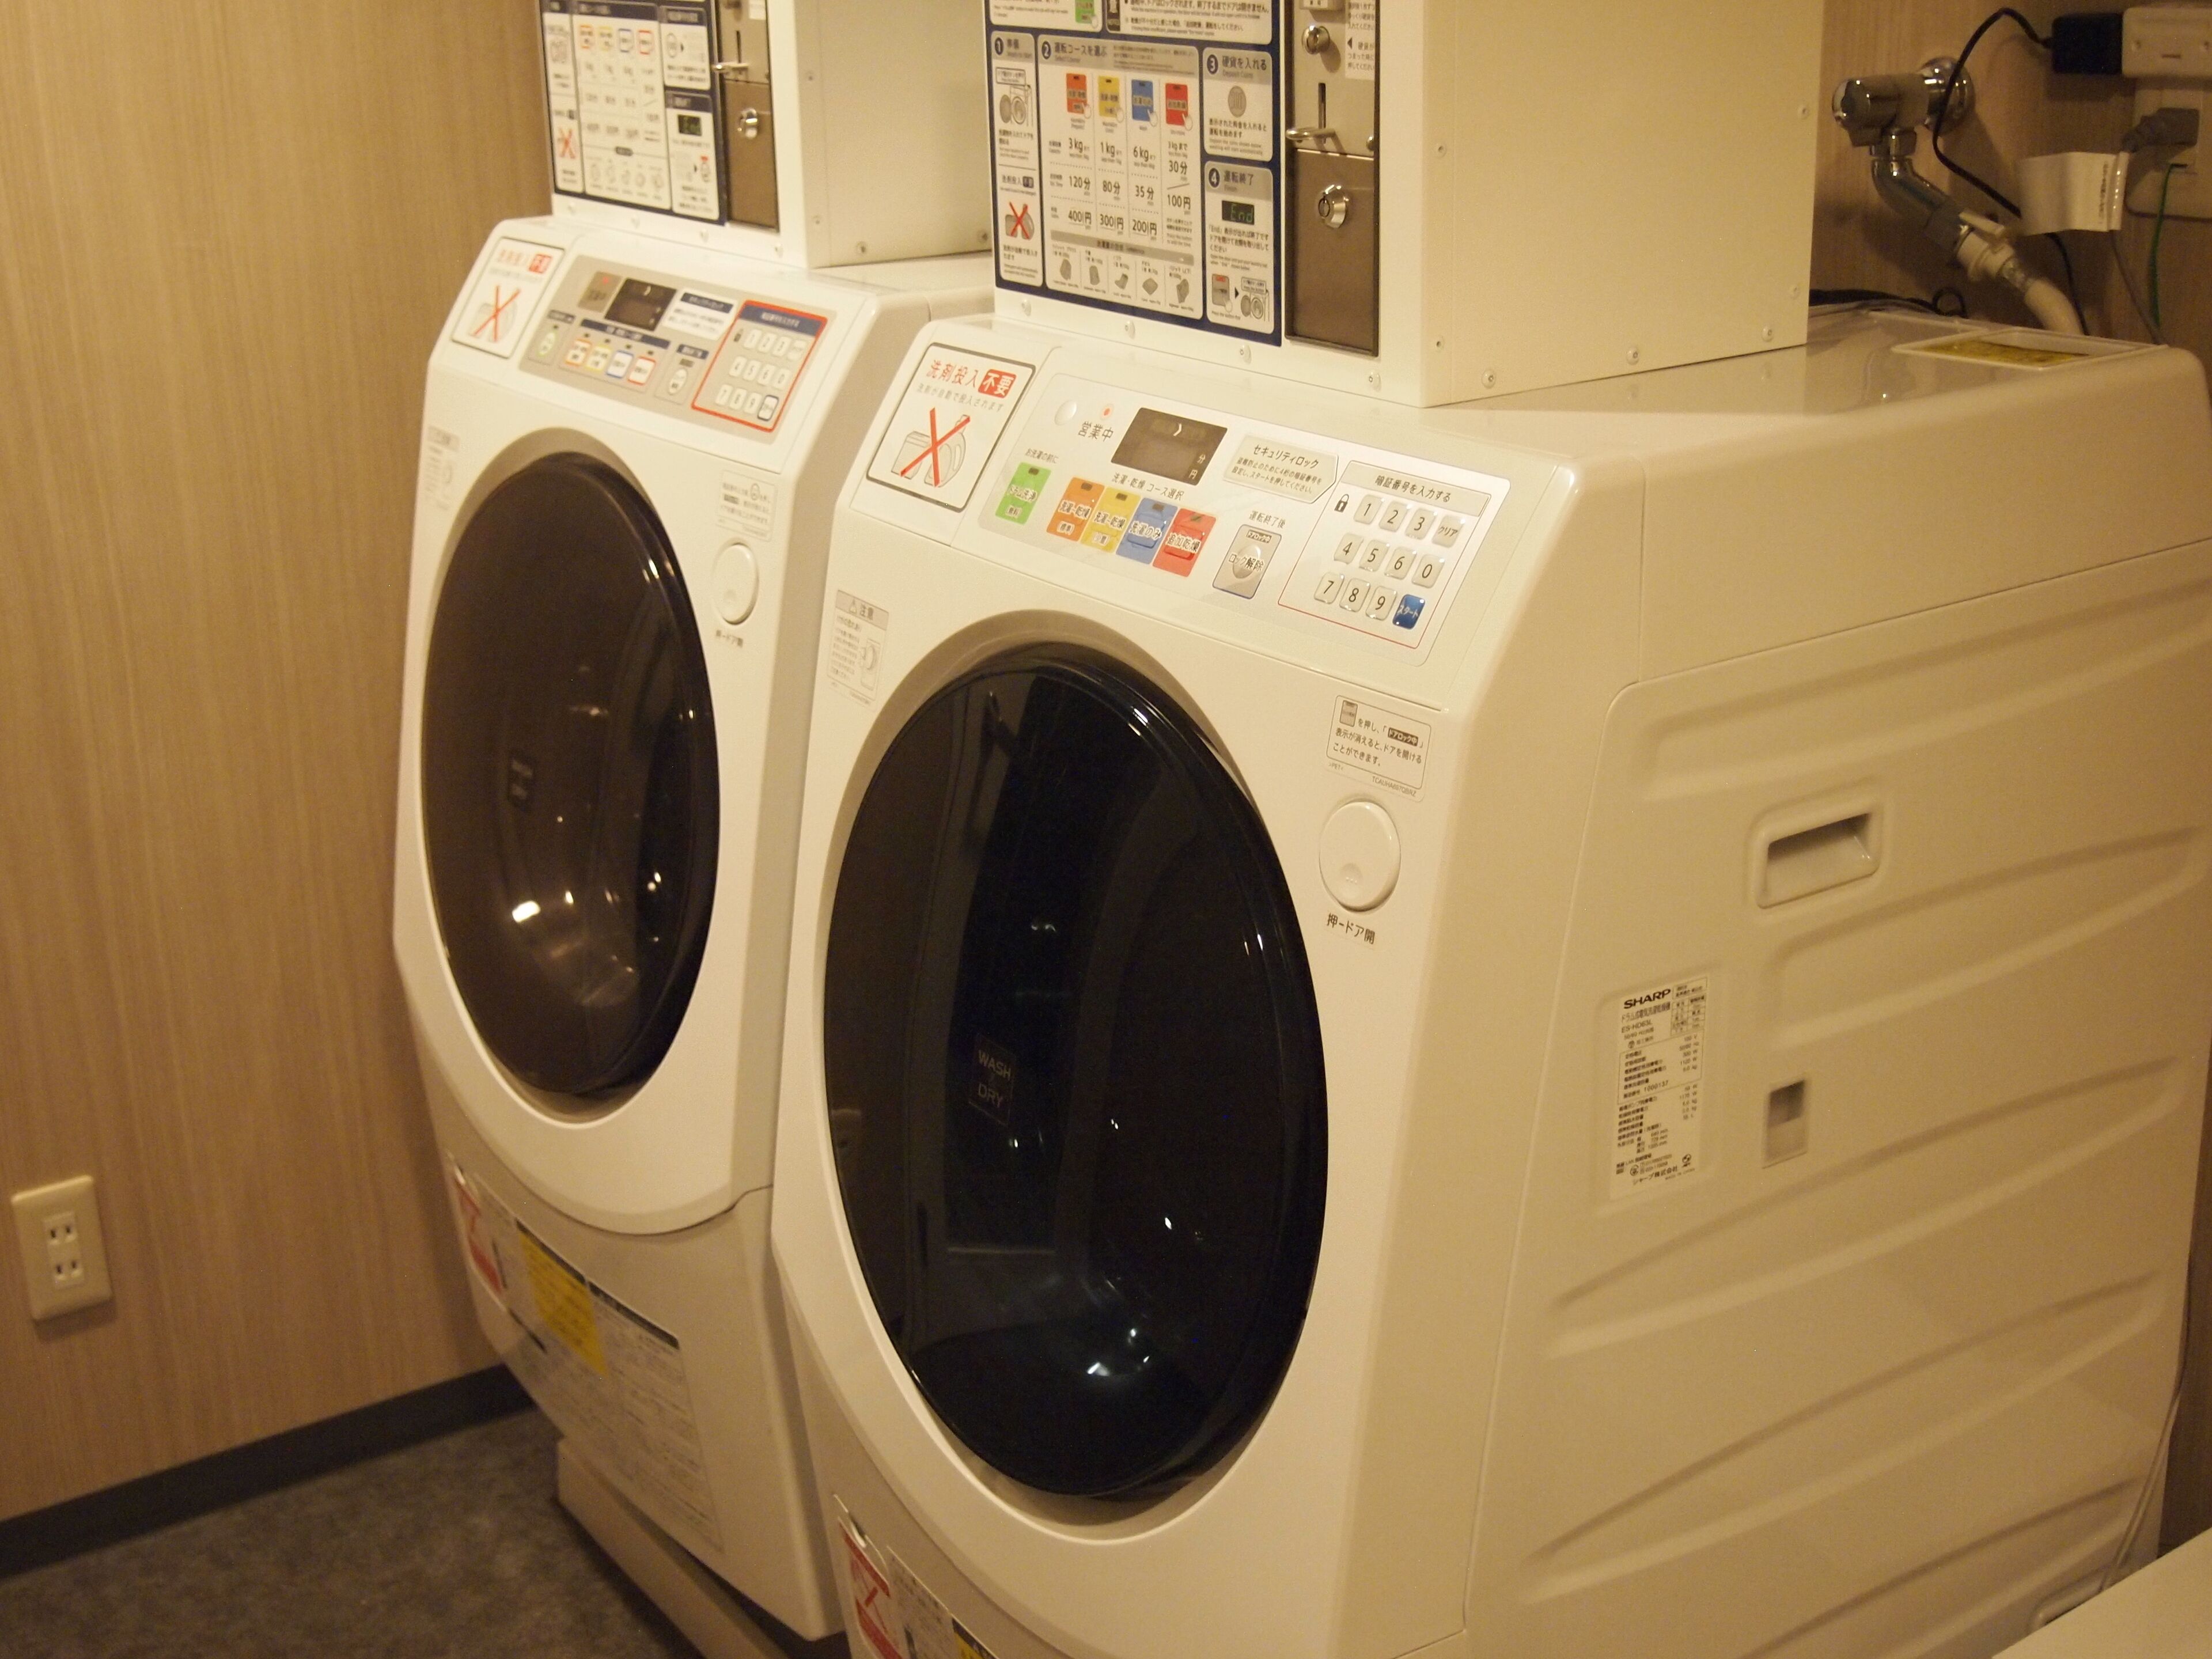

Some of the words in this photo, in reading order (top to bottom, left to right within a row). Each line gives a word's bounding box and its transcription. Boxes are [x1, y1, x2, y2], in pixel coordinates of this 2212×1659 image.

[1222, 55, 1266, 71] 硬貨を入れる
[1169, 161, 1187, 175] 30分
[1069, 176, 1090, 191] 120分
[1103, 180, 1120, 196] 80分
[1224, 171, 1253, 186] 運転終了
[1135, 185, 1154, 200] 35分
[1167, 194, 1191, 210] 100円
[1230, 203, 1253, 223] End
[926, 359, 979, 388] 洗剤投入
[983, 372, 1014, 396] 不要
[1078, 421, 1114, 442] 営業中
[1197, 454, 1206, 464] 分
[1253, 445, 1319, 469] セキュリティロック
[1189, 469, 1198, 480] 円
[1146, 482, 1184, 502] コース選択
[1375, 475, 1451, 503] 暗証番号を入力する
[1249, 510, 1286, 529] 運転終了後
[1365, 503, 1372, 517] 1
[1387, 510, 1399, 524] 2
[1414, 517, 1425, 531] 3
[1438, 525, 1458, 537] クリア
[1130, 521, 1162, 540] 洗濯のみ
[1168, 532, 1201, 552] 追加乾燥
[1229, 554, 1264, 571] ロック解除
[1343, 542, 1353, 556] 4
[1368, 548, 1378, 563] 5
[1394, 556, 1405, 570] 6
[1422, 564, 1433, 579] 0
[1324, 580, 1334, 594] 7
[1349, 588, 1359, 603] 8
[1375, 596, 1385, 611] 9
[1399, 605, 1419, 619] スタート
[1333, 742, 1381, 767] ことができます。
[1335, 726, 1422, 764] 表示が消えると、ドアを開ける
[1623, 988, 1671, 1009] SHARP
[979, 1050, 1012, 1081] WASH
[979, 1083, 1003, 1108] DRY
